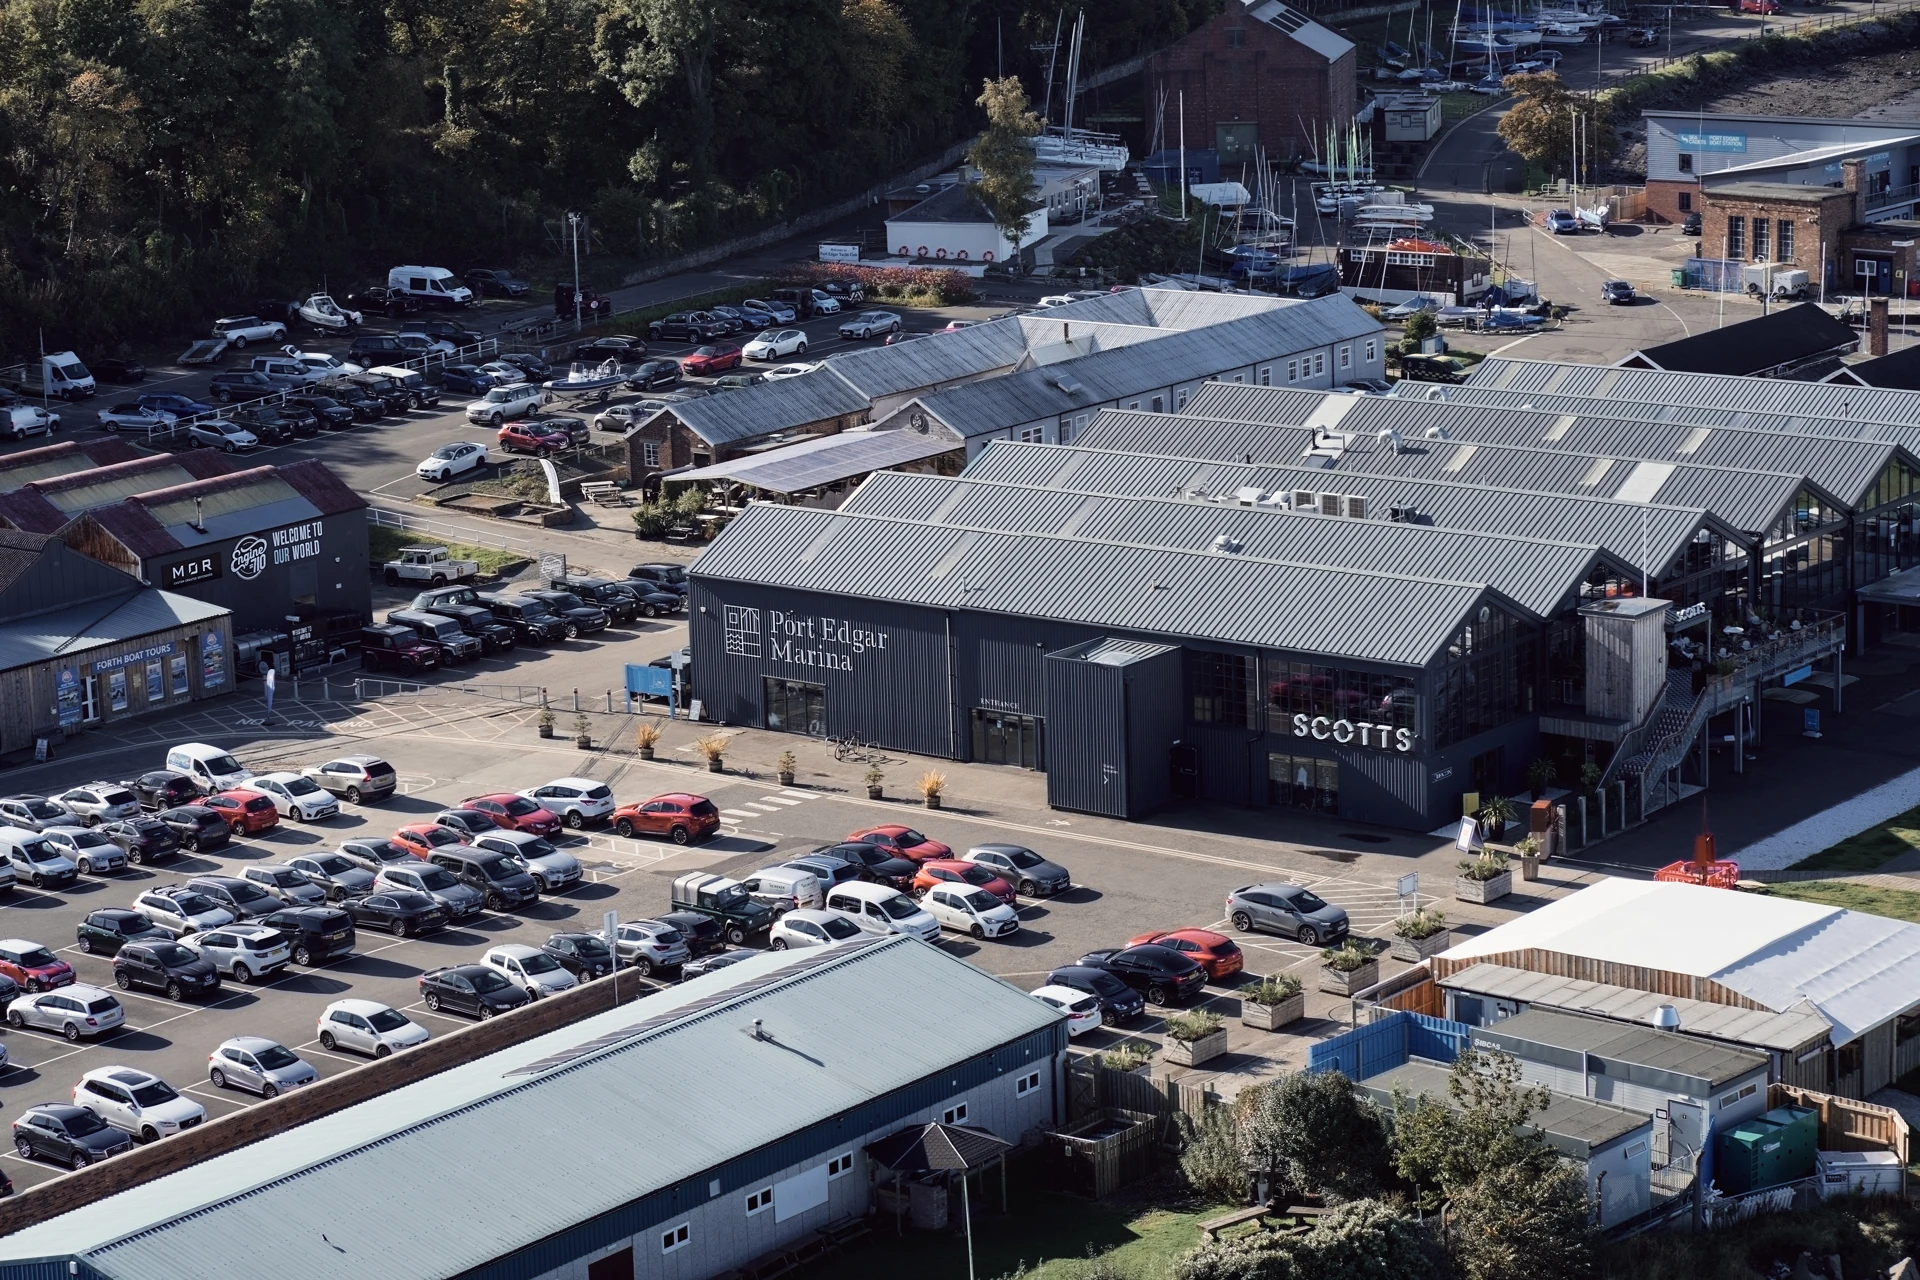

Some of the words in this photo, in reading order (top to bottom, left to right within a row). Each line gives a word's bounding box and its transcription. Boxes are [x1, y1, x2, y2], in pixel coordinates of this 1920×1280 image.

[272, 523, 311, 547] WELCOME
[312, 521, 323, 538] TO
[231, 539, 268, 573] Engine
[273, 547, 291, 565] OUR
[291, 540, 320, 561] WORLD
[1676, 601, 1705, 622] SCOTTS
[769, 610, 815, 639] Port
[820, 617, 888, 653] Edgar
[96, 656, 123, 671] FORTH
[124, 651, 144, 664] BOAT
[145, 643, 171, 657] TOURS
[770, 637, 853, 672] Marina
[980, 697, 1020, 710] ENTRANCE
[235, 718, 266, 726] NO
[286, 720, 375, 728] PARKING
[1293, 713, 1412, 752] SCOTTS
[1474, 1038, 1501, 1050] SIBCAS
